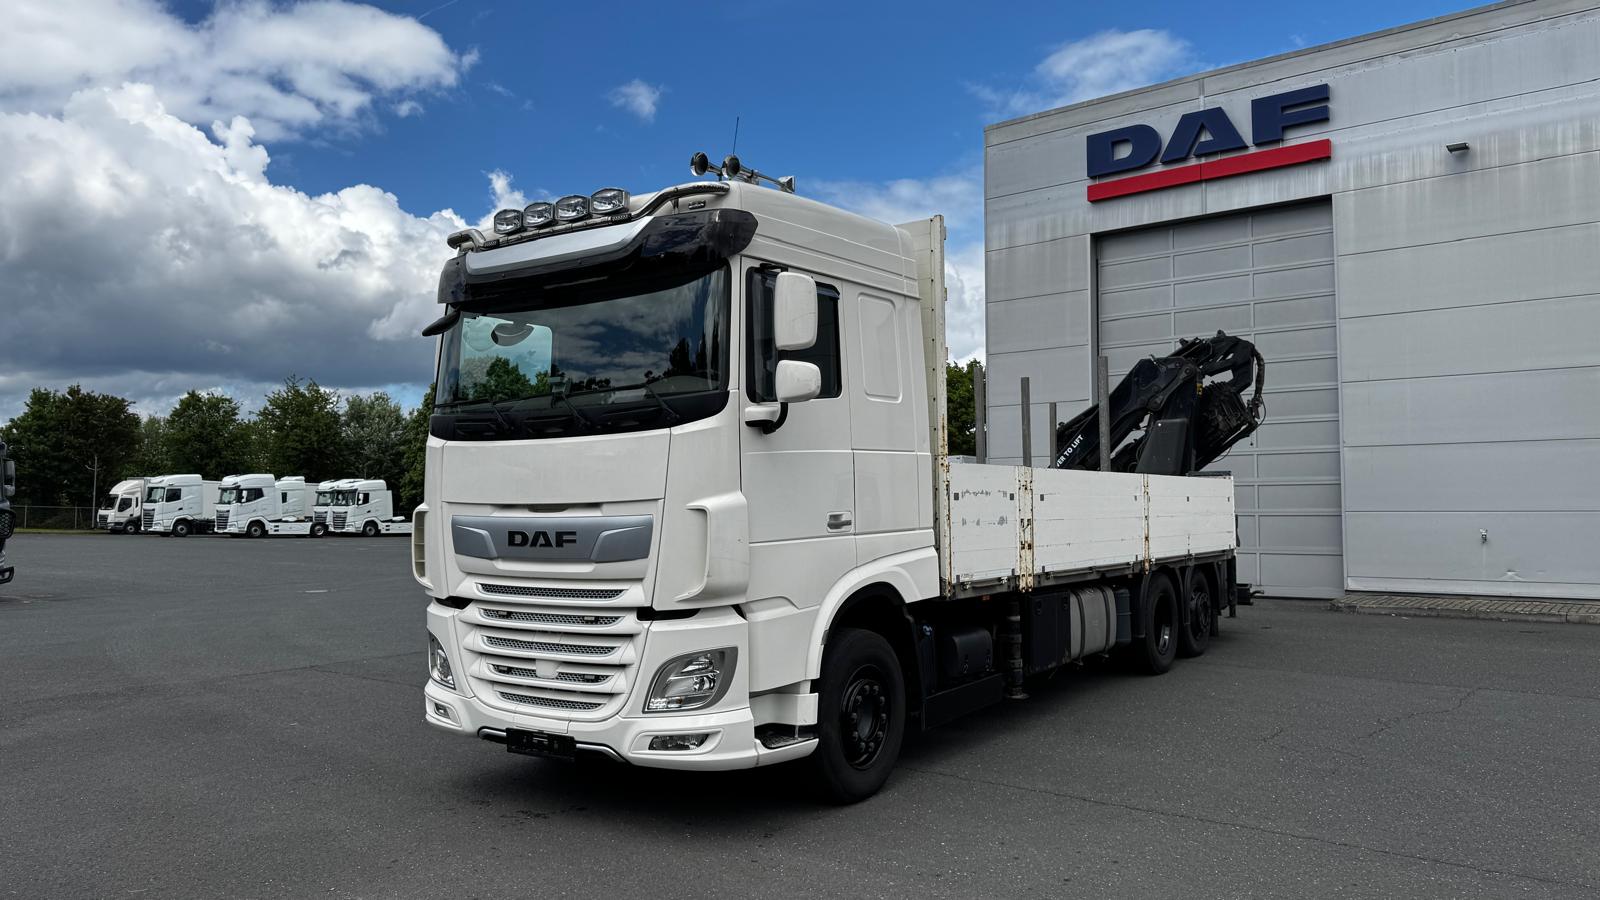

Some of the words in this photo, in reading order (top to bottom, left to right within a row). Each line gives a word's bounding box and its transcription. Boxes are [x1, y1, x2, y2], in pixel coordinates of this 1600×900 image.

[1087, 83, 1330, 179] DAF
[1063, 447, 1073, 456] TO
[1071, 434, 1084, 448] LIFT
[507, 530, 577, 548] DAF
